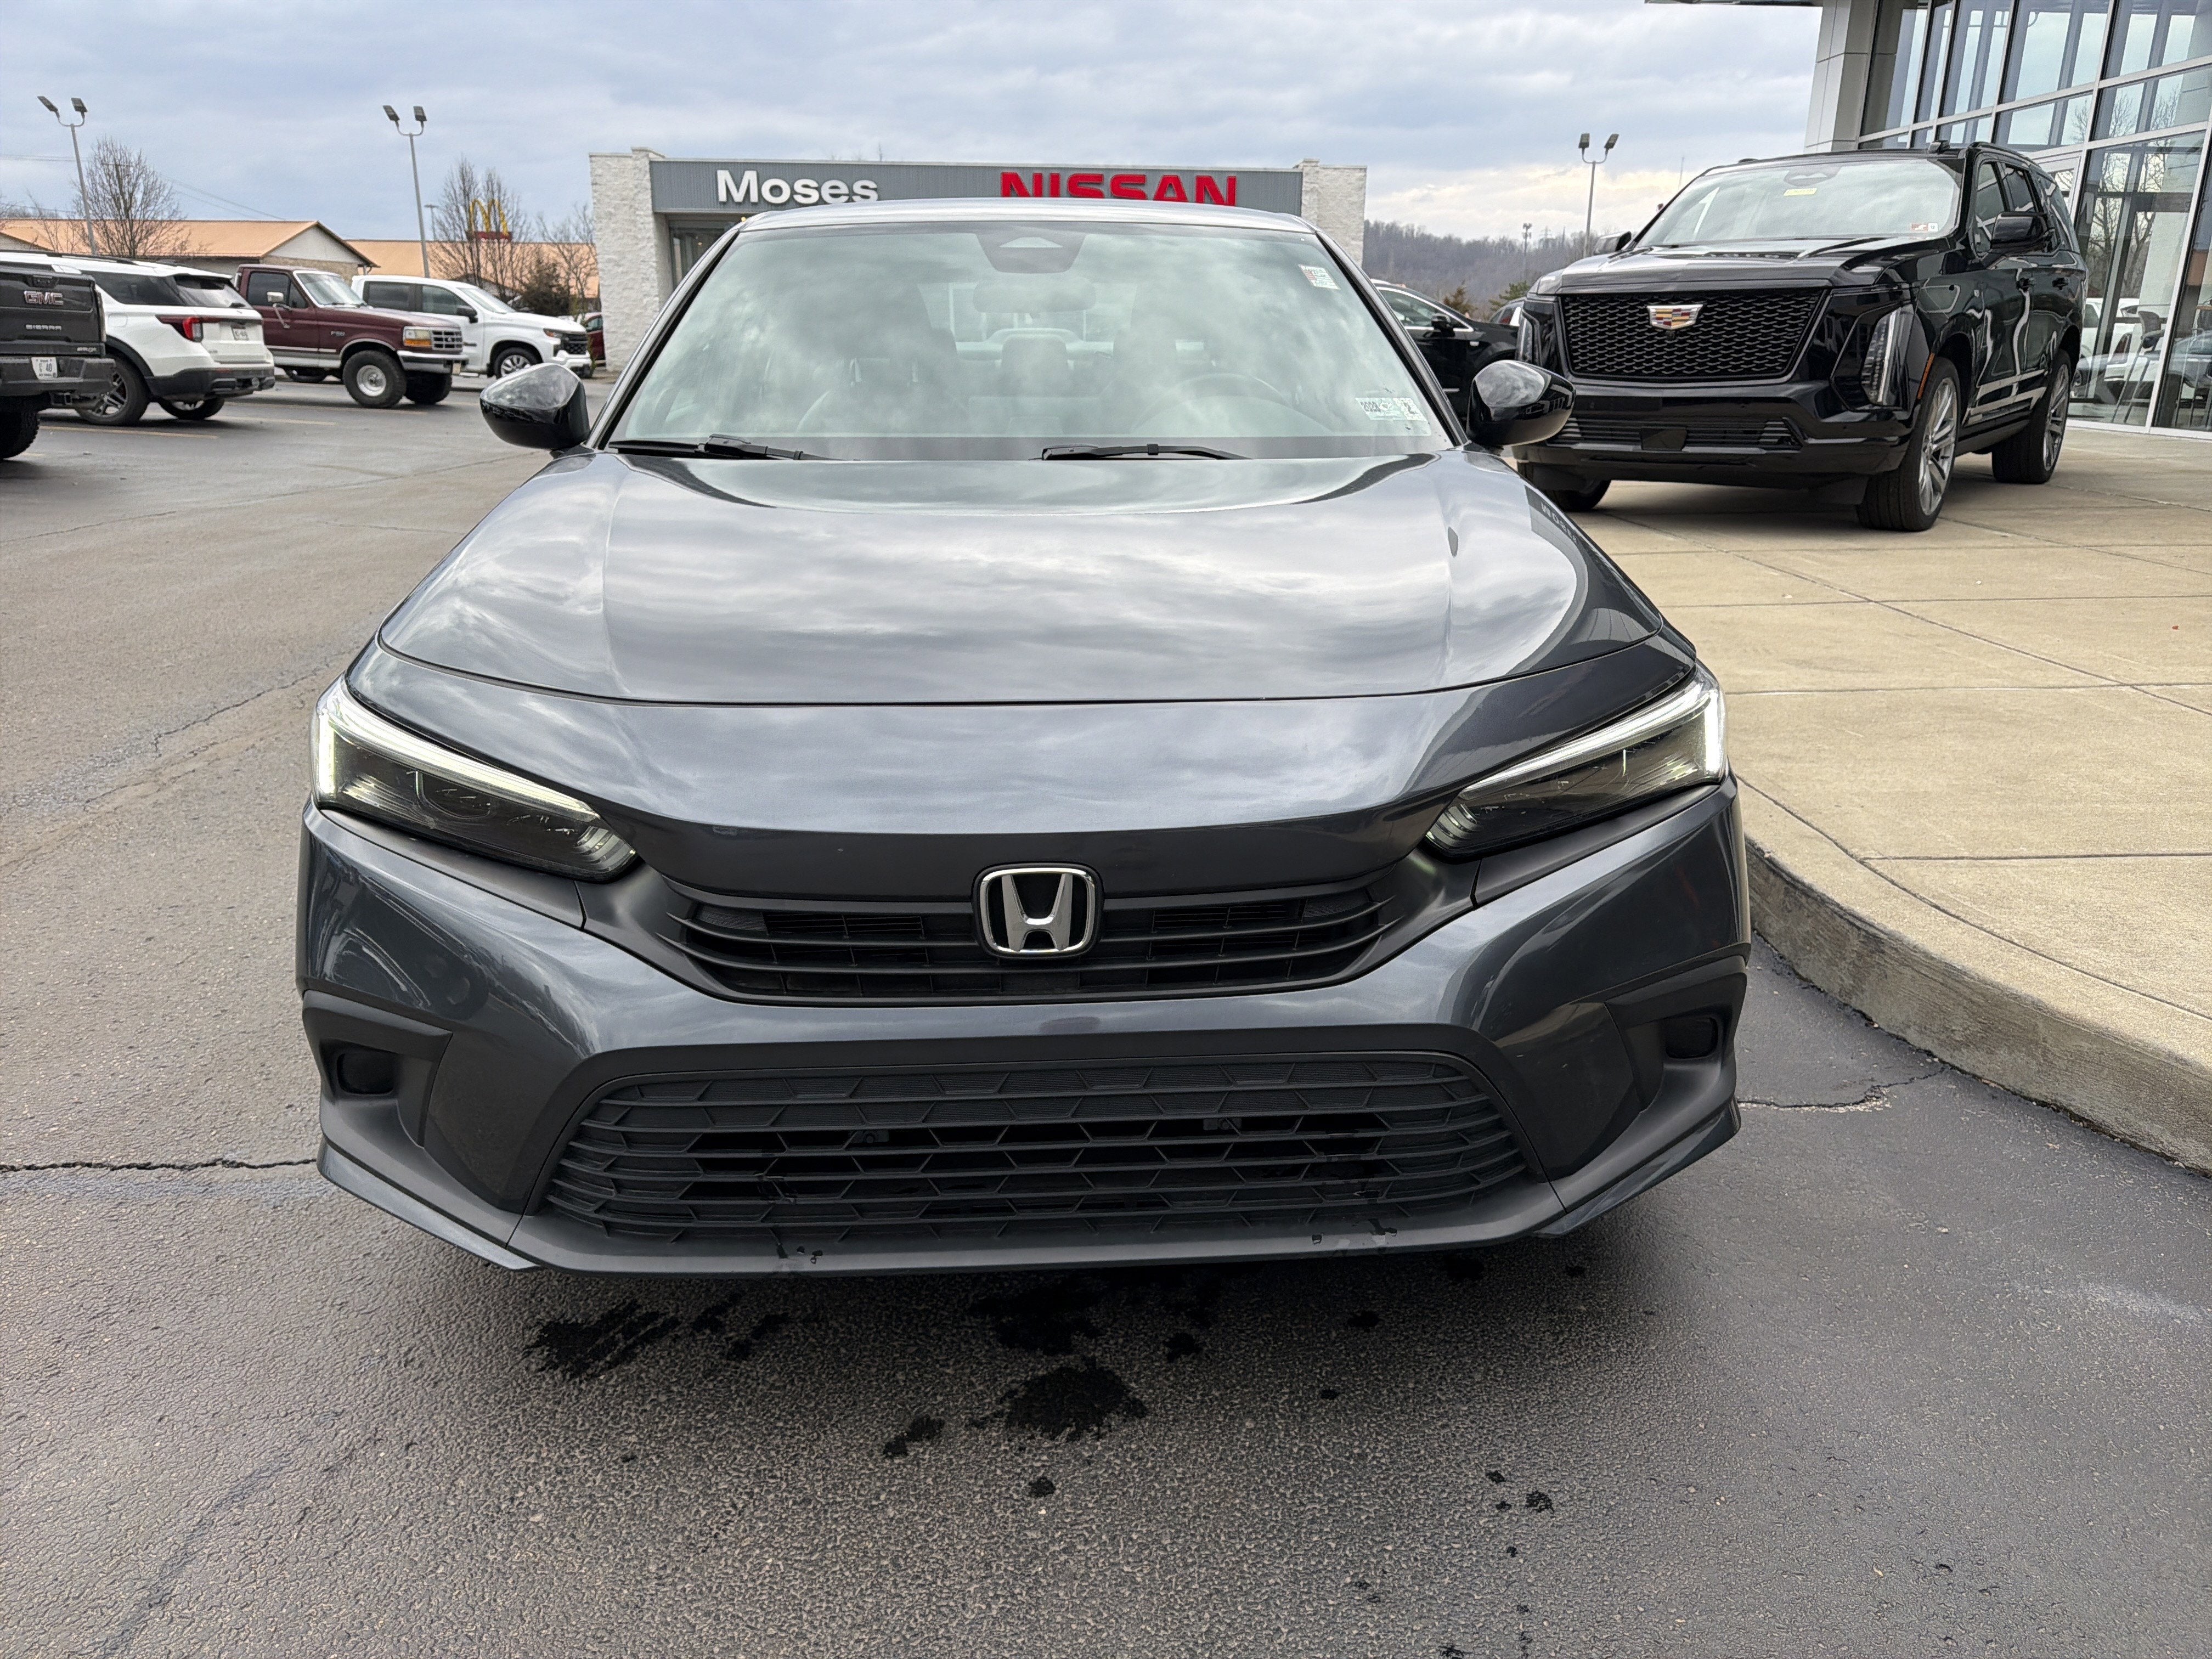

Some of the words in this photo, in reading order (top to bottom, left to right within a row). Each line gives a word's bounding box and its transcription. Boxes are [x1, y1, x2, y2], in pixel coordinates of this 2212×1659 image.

[716, 170, 878, 204] Moses
[1001, 172, 1238, 207] NISSAN
[24, 290, 64, 306] GMC
